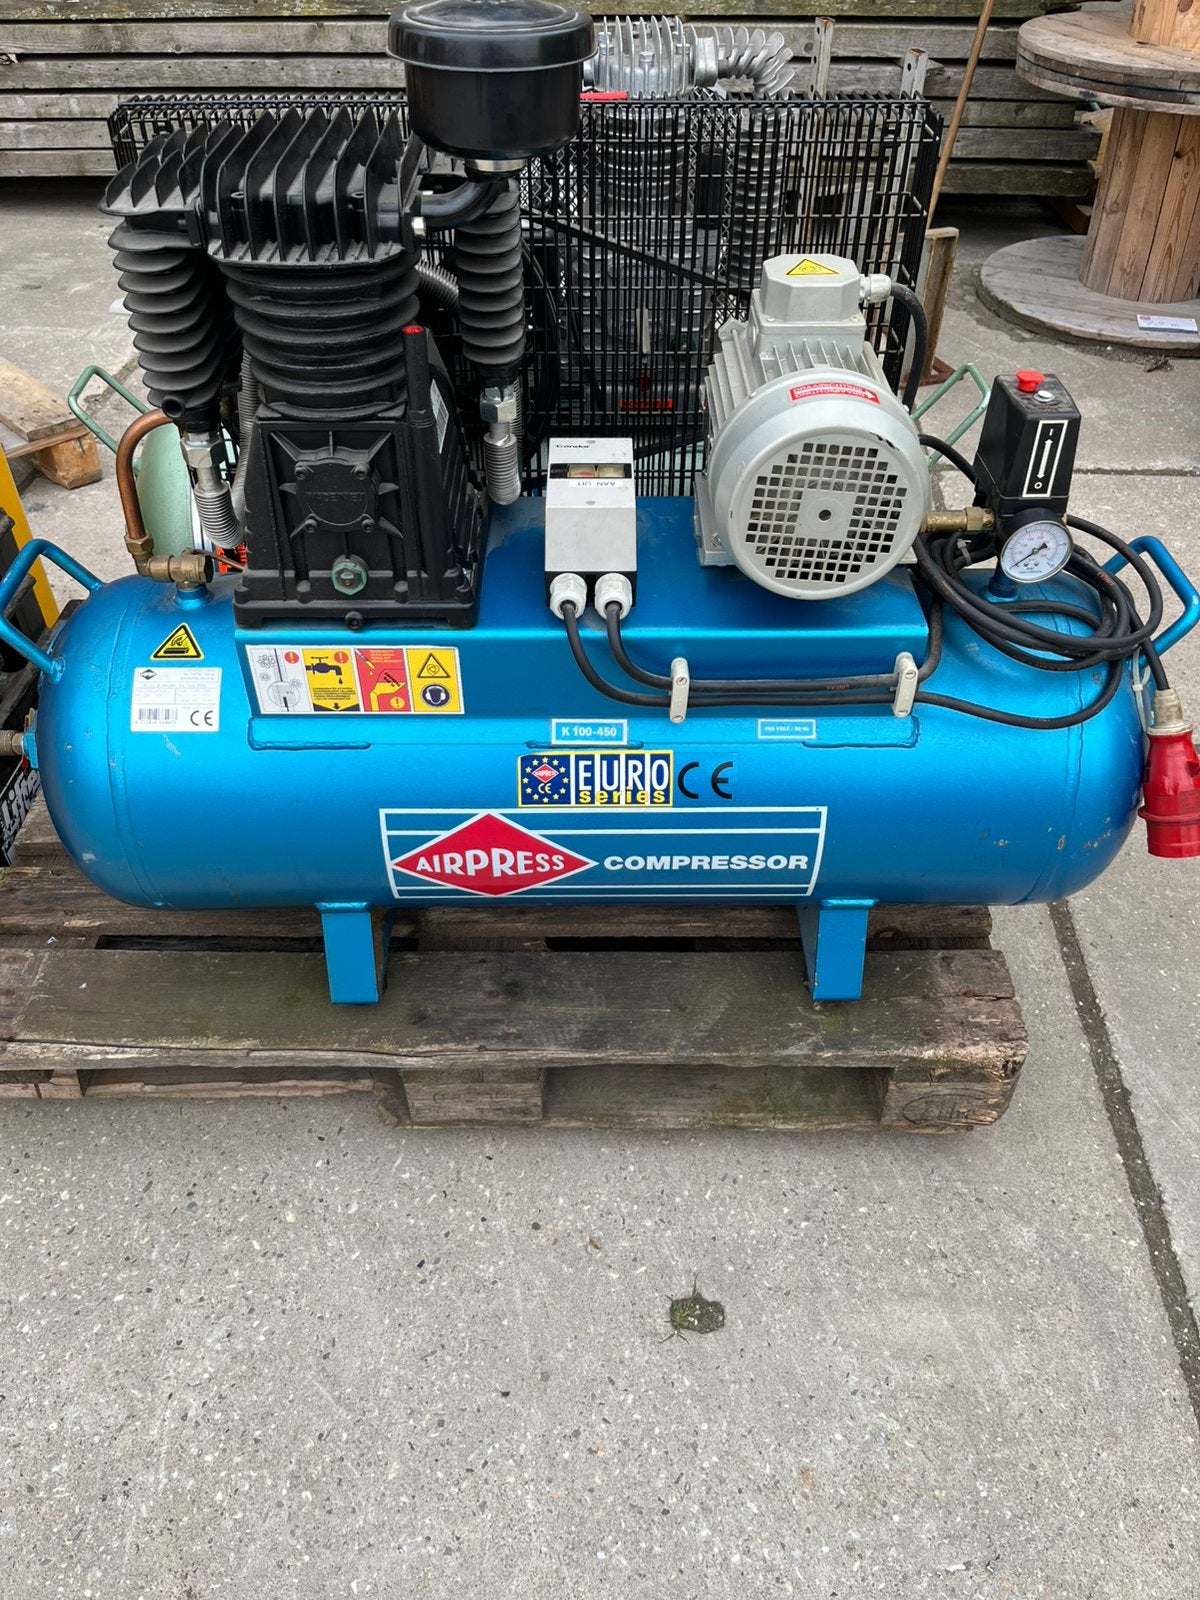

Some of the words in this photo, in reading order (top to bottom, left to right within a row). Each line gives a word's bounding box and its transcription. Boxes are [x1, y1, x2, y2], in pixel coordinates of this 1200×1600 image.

[561, 726, 570, 736] K
[573, 726, 617, 737] 100-450
[578, 759, 669, 791] EURO
[579, 786, 666, 803] series
[416, 847, 565, 878] AIRPRESS
[603, 854, 808, 871] COMPRESSOR
